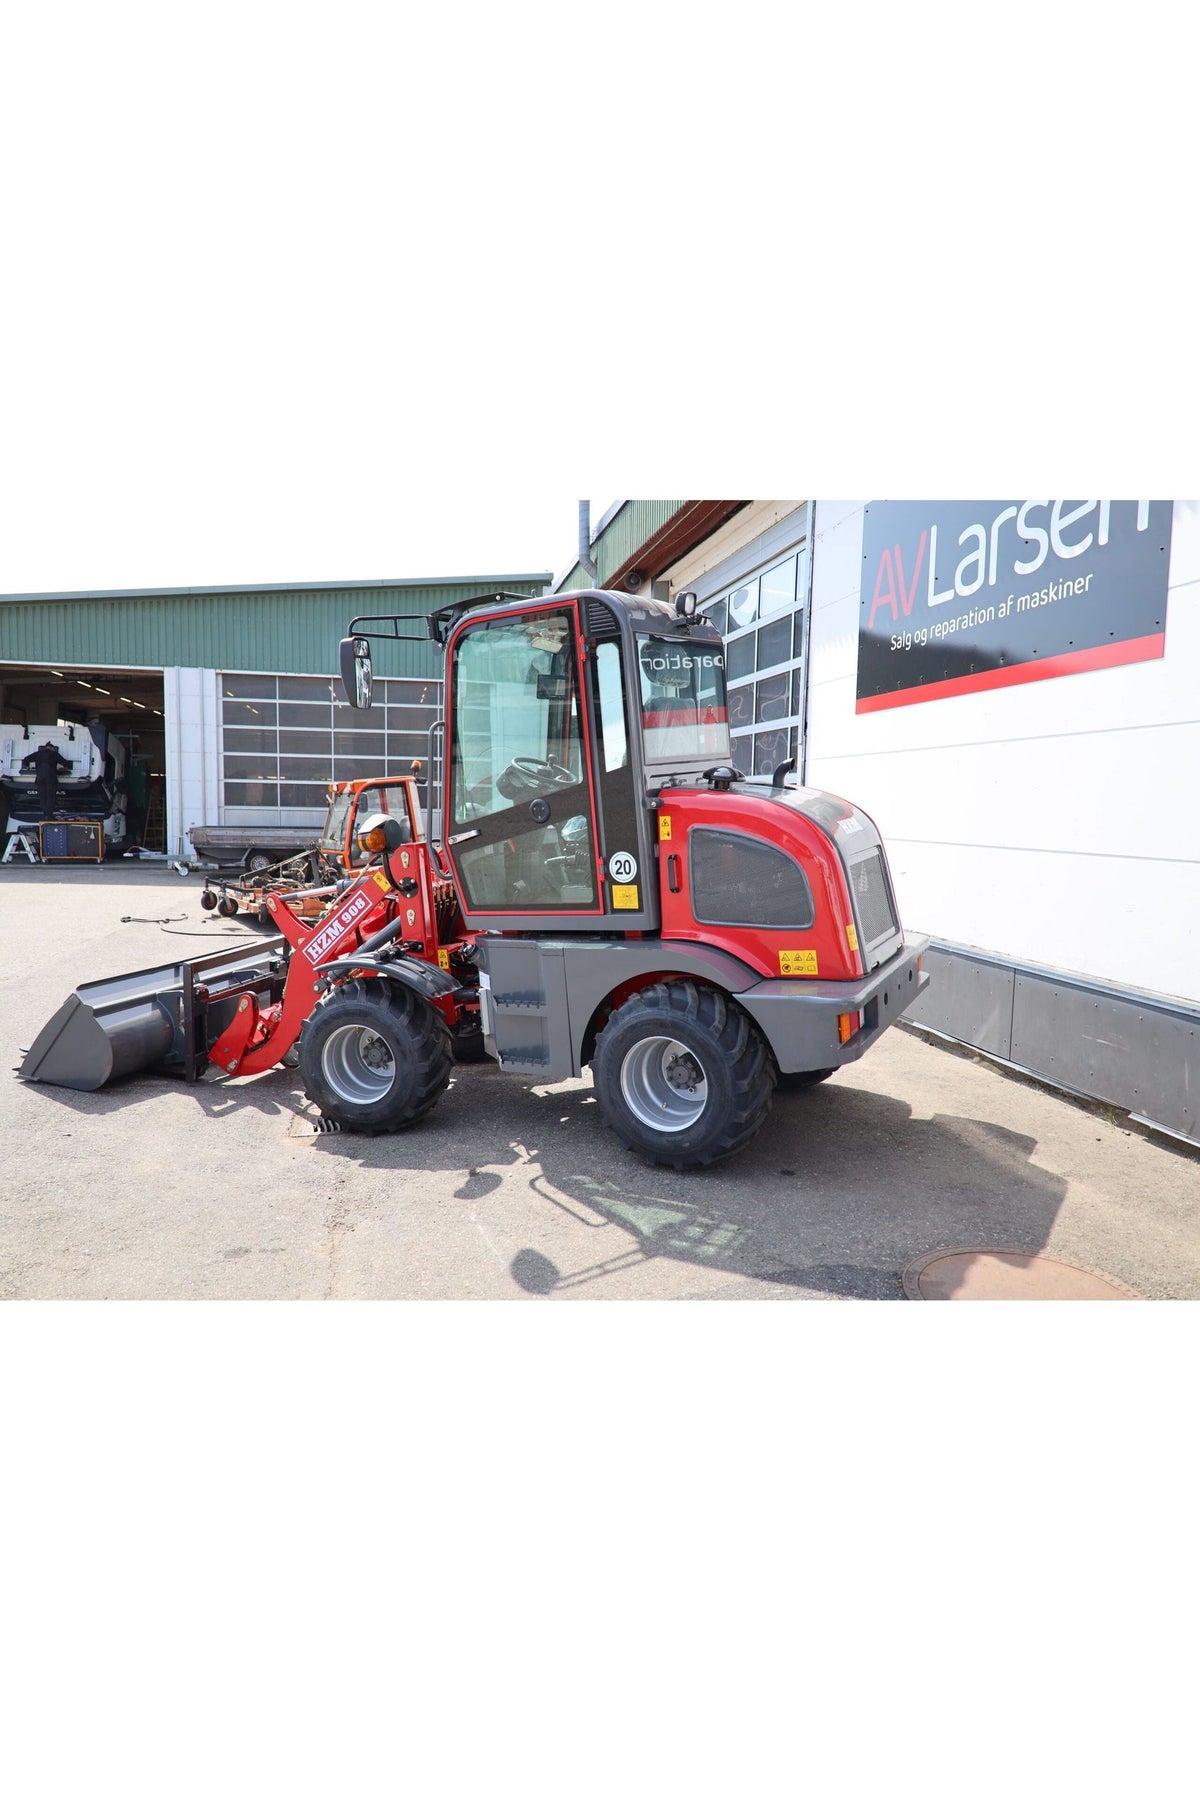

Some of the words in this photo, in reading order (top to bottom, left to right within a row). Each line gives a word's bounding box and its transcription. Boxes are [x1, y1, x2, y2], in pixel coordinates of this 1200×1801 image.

[890, 630, 912, 651] Salg
[914, 628, 928, 646] og
[930, 606, 995, 640] reparation
[998, 594, 1014, 618] af
[1017, 573, 1094, 613] maskiner
[614, 859, 632, 876] 20
[307, 919, 345, 960] HZM
[341, 897, 366, 924] 908
